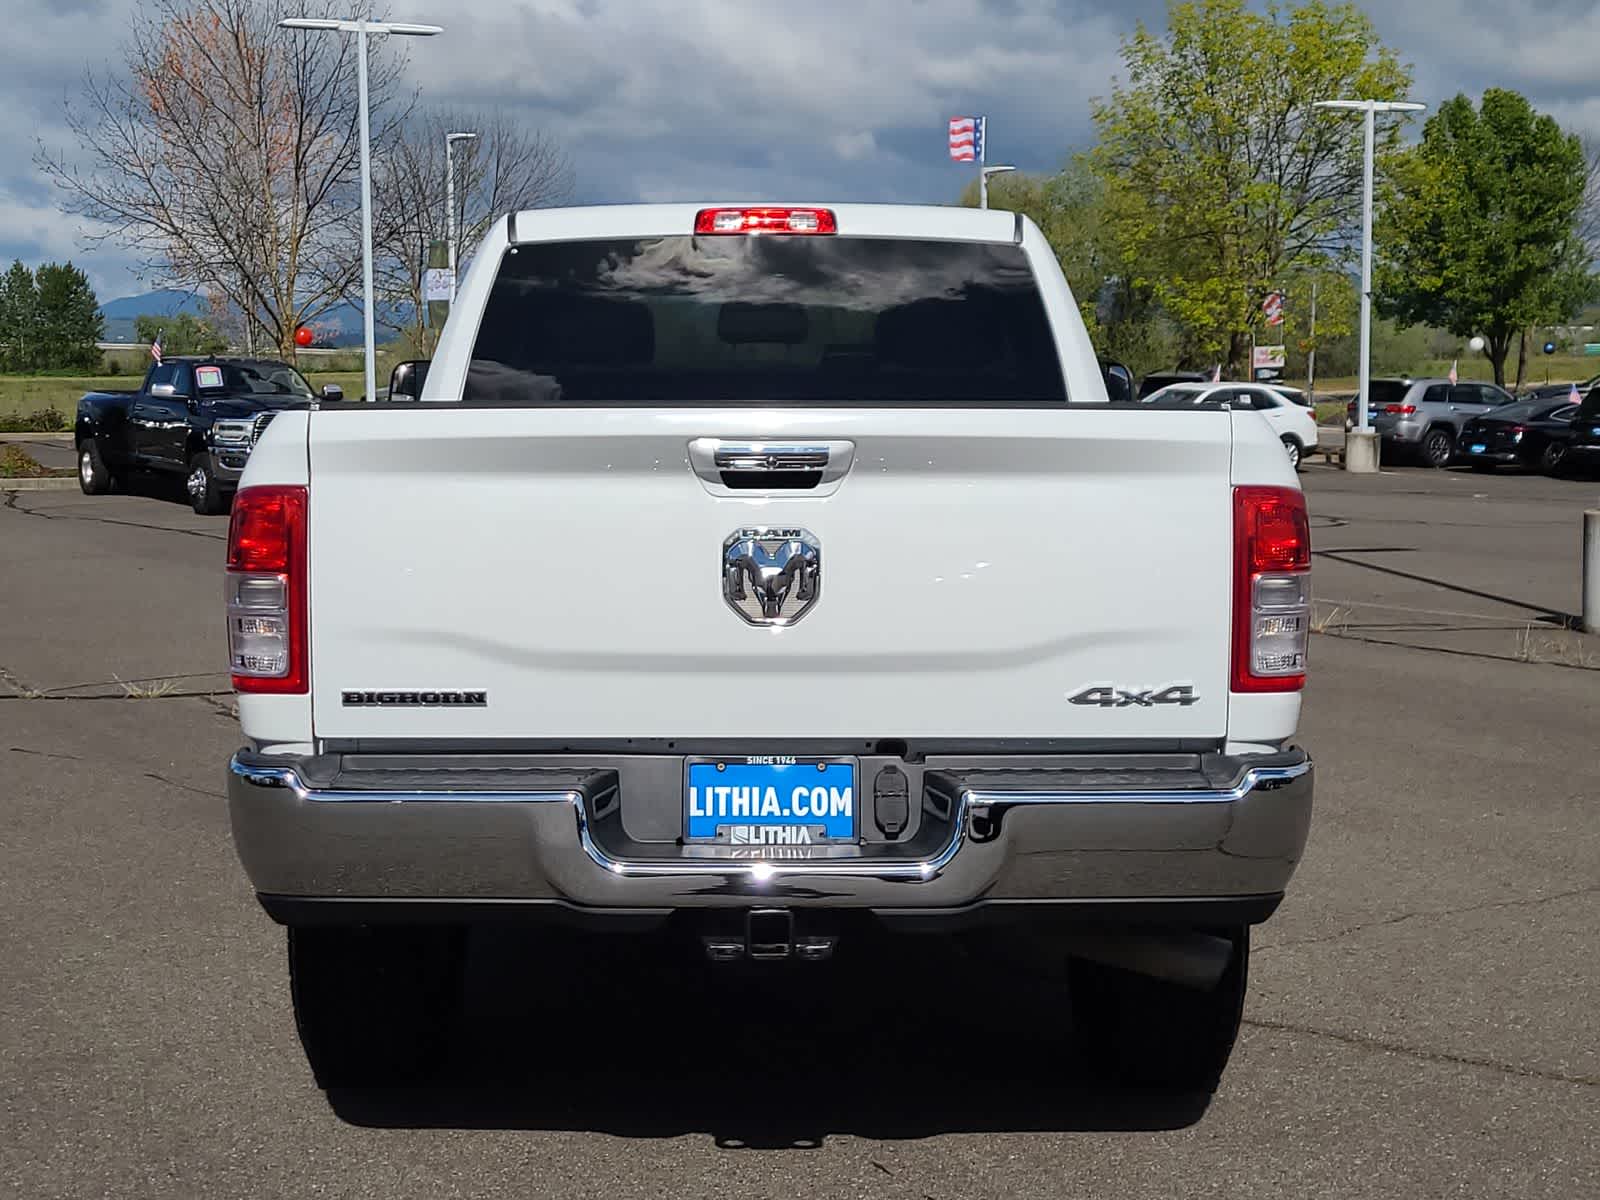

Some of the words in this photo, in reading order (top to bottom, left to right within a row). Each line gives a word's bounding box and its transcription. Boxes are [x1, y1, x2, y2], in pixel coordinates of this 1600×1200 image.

[742, 529, 801, 538] RAM
[341, 691, 488, 707] BIGHORN
[1067, 685, 1200, 707] 4x4
[746, 756, 774, 765] SINCE
[776, 756, 797, 765] 1946
[689, 786, 853, 817] LITHIA.COM
[749, 826, 812, 845] LITHIA
